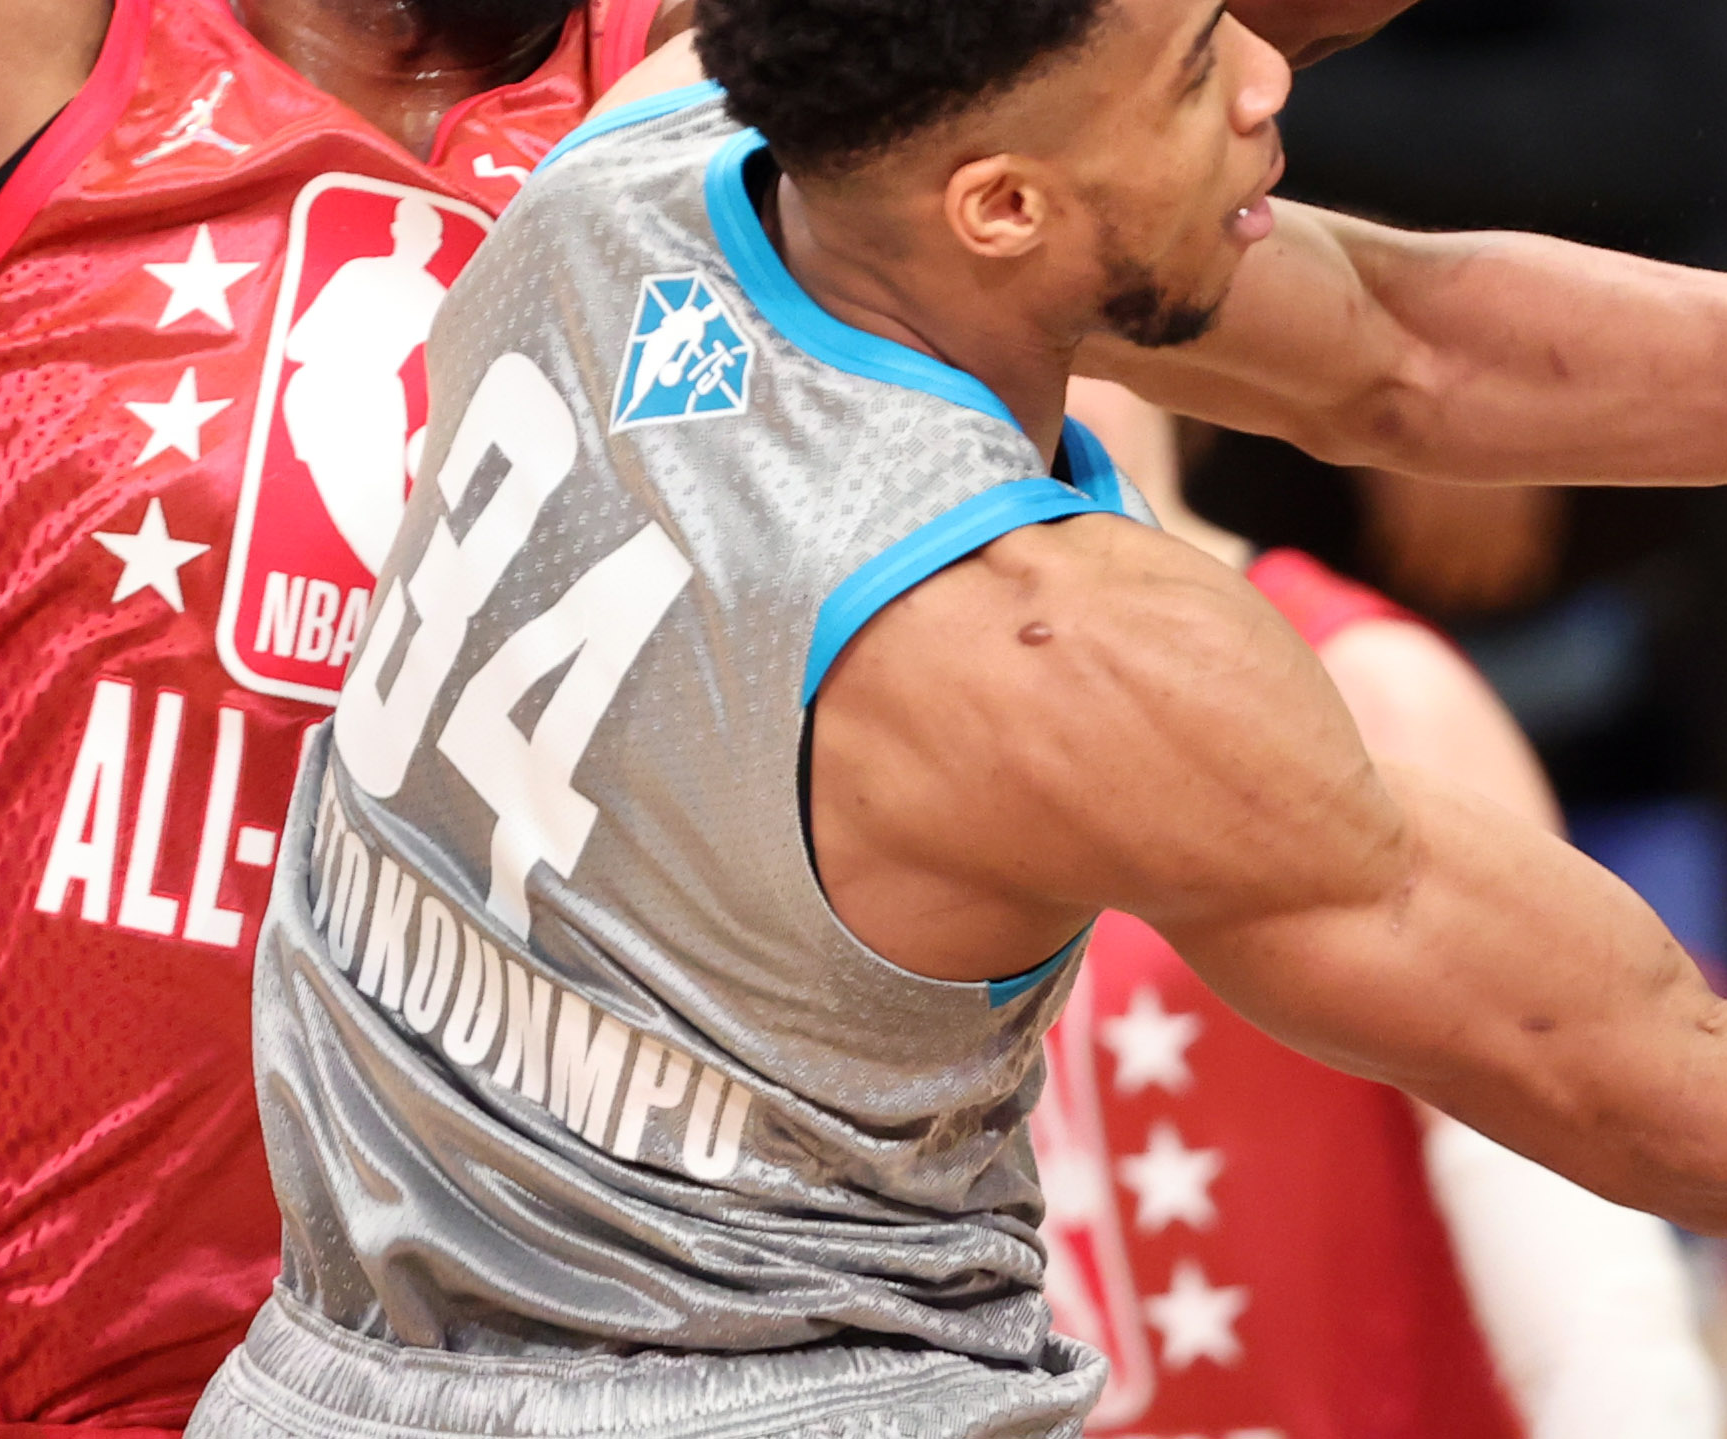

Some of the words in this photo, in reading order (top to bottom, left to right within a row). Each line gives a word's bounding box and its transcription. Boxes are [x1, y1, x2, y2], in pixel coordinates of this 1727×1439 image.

[686, 339, 736, 396] 75
[253, 569, 371, 667] NBA
[333, 351, 694, 944] 34
[34, 678, 324, 949] ALL-
